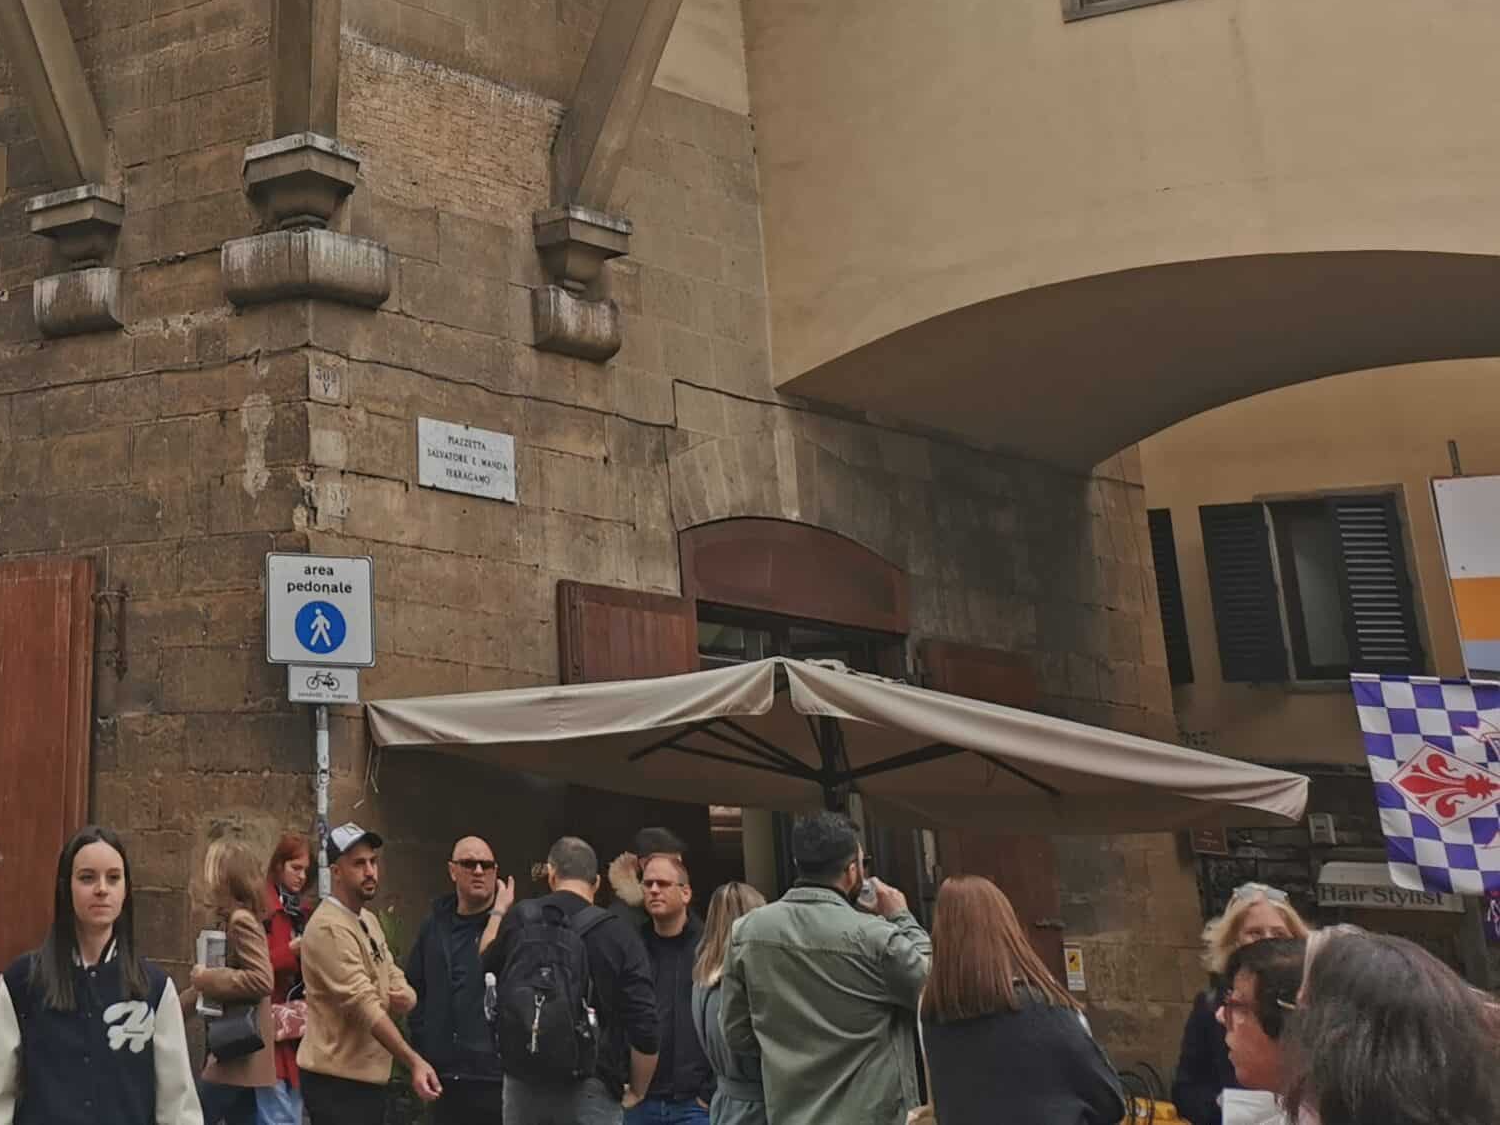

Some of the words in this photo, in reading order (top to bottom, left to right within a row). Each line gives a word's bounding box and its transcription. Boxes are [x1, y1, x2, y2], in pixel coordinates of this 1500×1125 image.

[447, 435, 487, 452] PIAZZETTA
[427, 448, 469, 465] SALVATORE
[481, 458, 509, 472] WANDA
[303, 564, 335, 577] area
[286, 579, 353, 596] pedonale
[1321, 885, 1368, 902] Hair
[1372, 886, 1444, 908] Stylist
